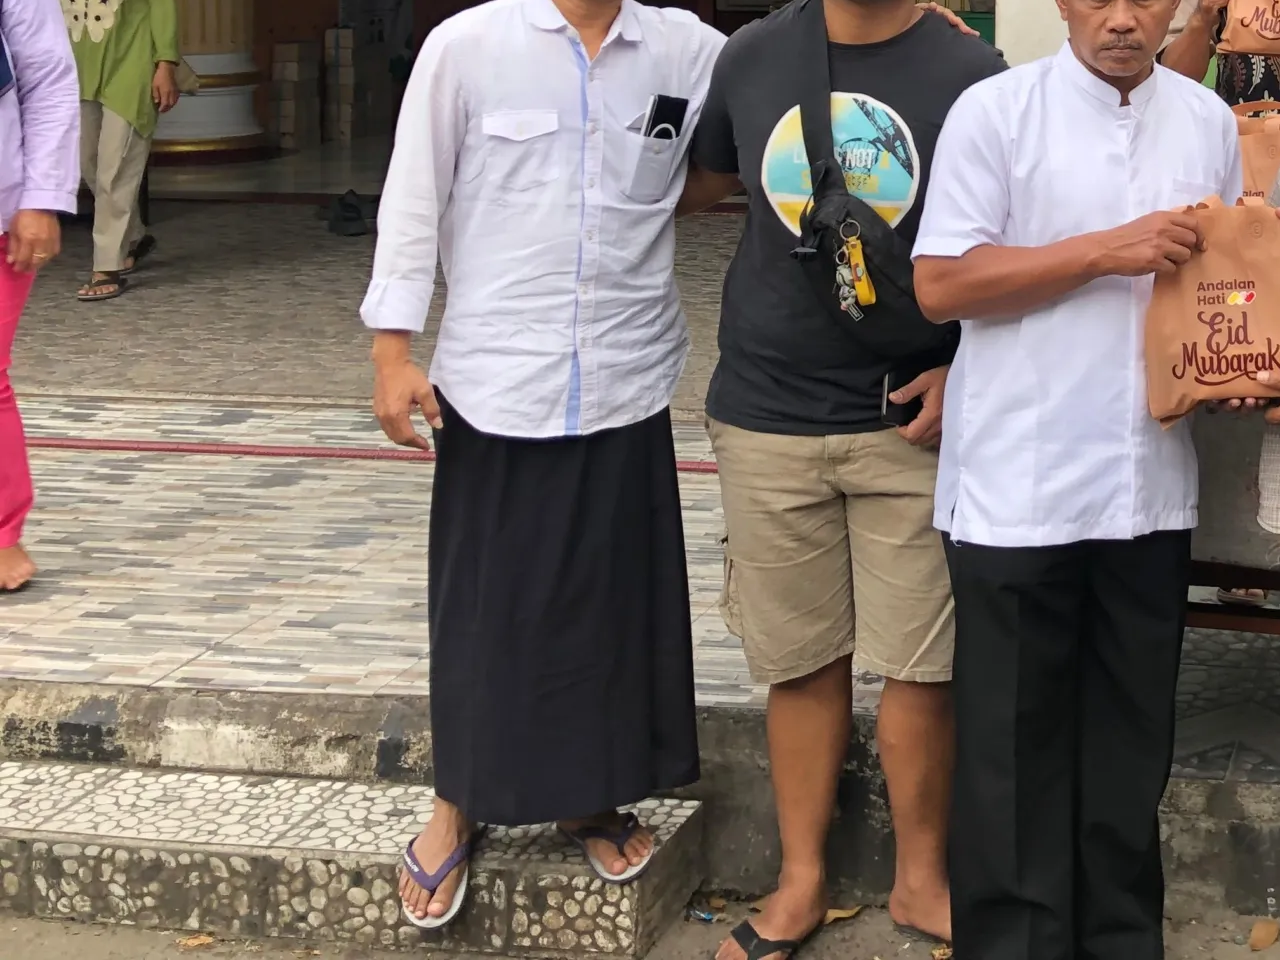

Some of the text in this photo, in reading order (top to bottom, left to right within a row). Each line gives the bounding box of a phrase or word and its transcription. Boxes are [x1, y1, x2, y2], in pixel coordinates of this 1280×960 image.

[845, 148, 877, 168] NOT
[1197, 278, 1255, 292] Andalan
[1197, 293, 1225, 306] Hati
[1197, 311, 1254, 355] Eid
